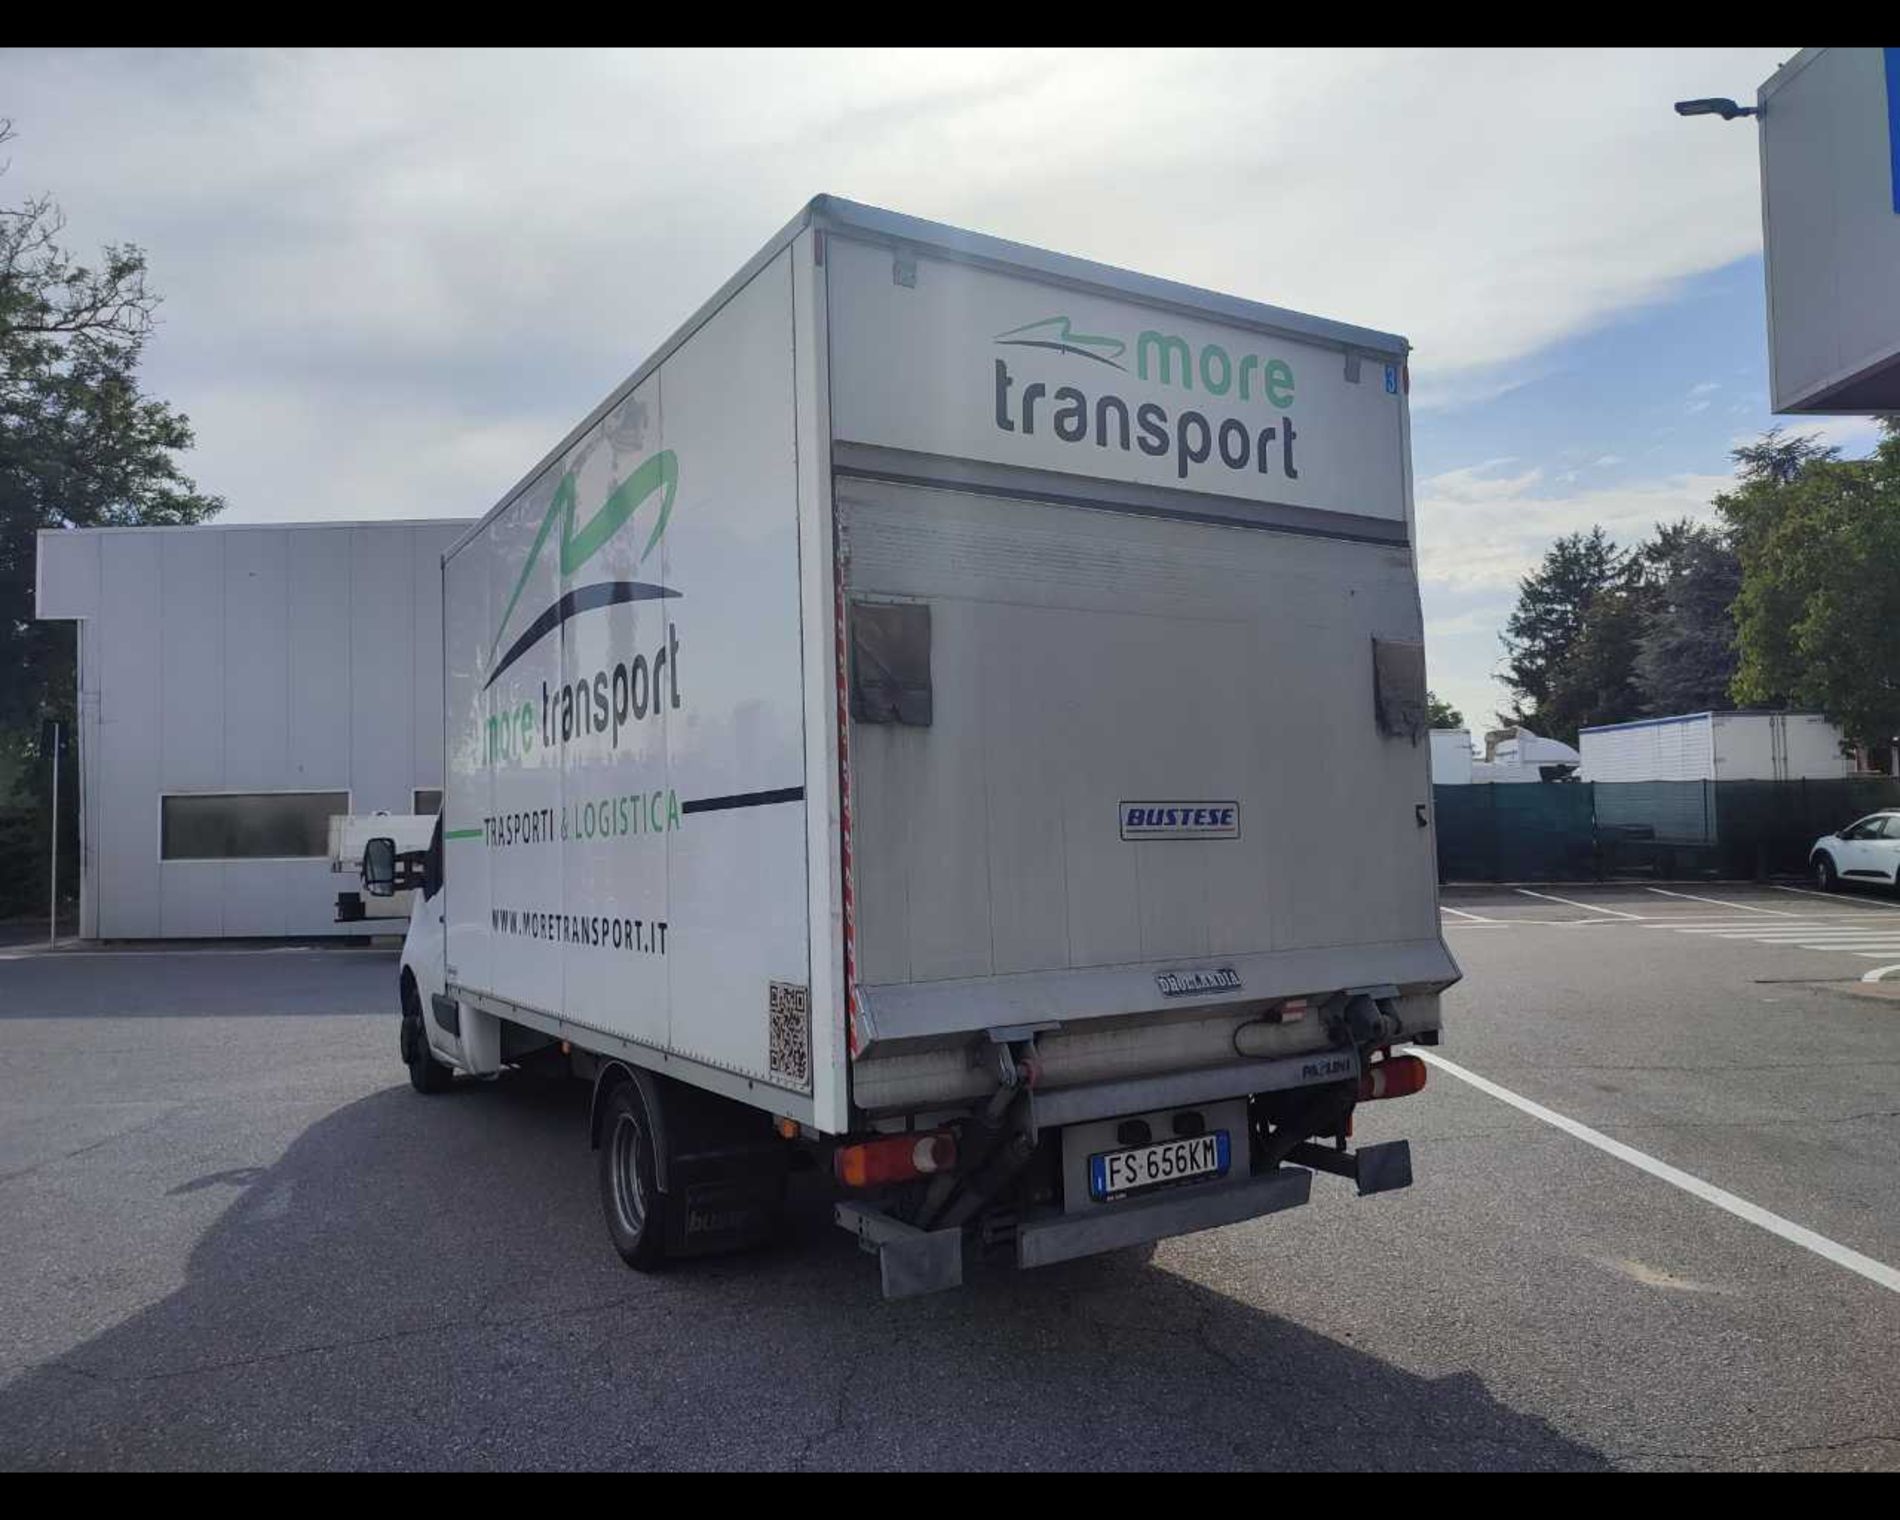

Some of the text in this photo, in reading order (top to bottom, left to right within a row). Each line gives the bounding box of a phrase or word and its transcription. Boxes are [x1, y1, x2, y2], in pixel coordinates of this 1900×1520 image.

[1137, 329, 1296, 409] more
[995, 358, 1299, 479] transport
[543, 622, 680, 749] transport
[484, 809, 553, 847] TRASPORTI
[574, 789, 680, 839] LOGISTICA
[1126, 807, 1234, 827] BUSTESE
[492, 909, 668, 955] WWW.MORETRANSPORT.IT
[1109, 1138, 1217, 1189] FS 656KM
